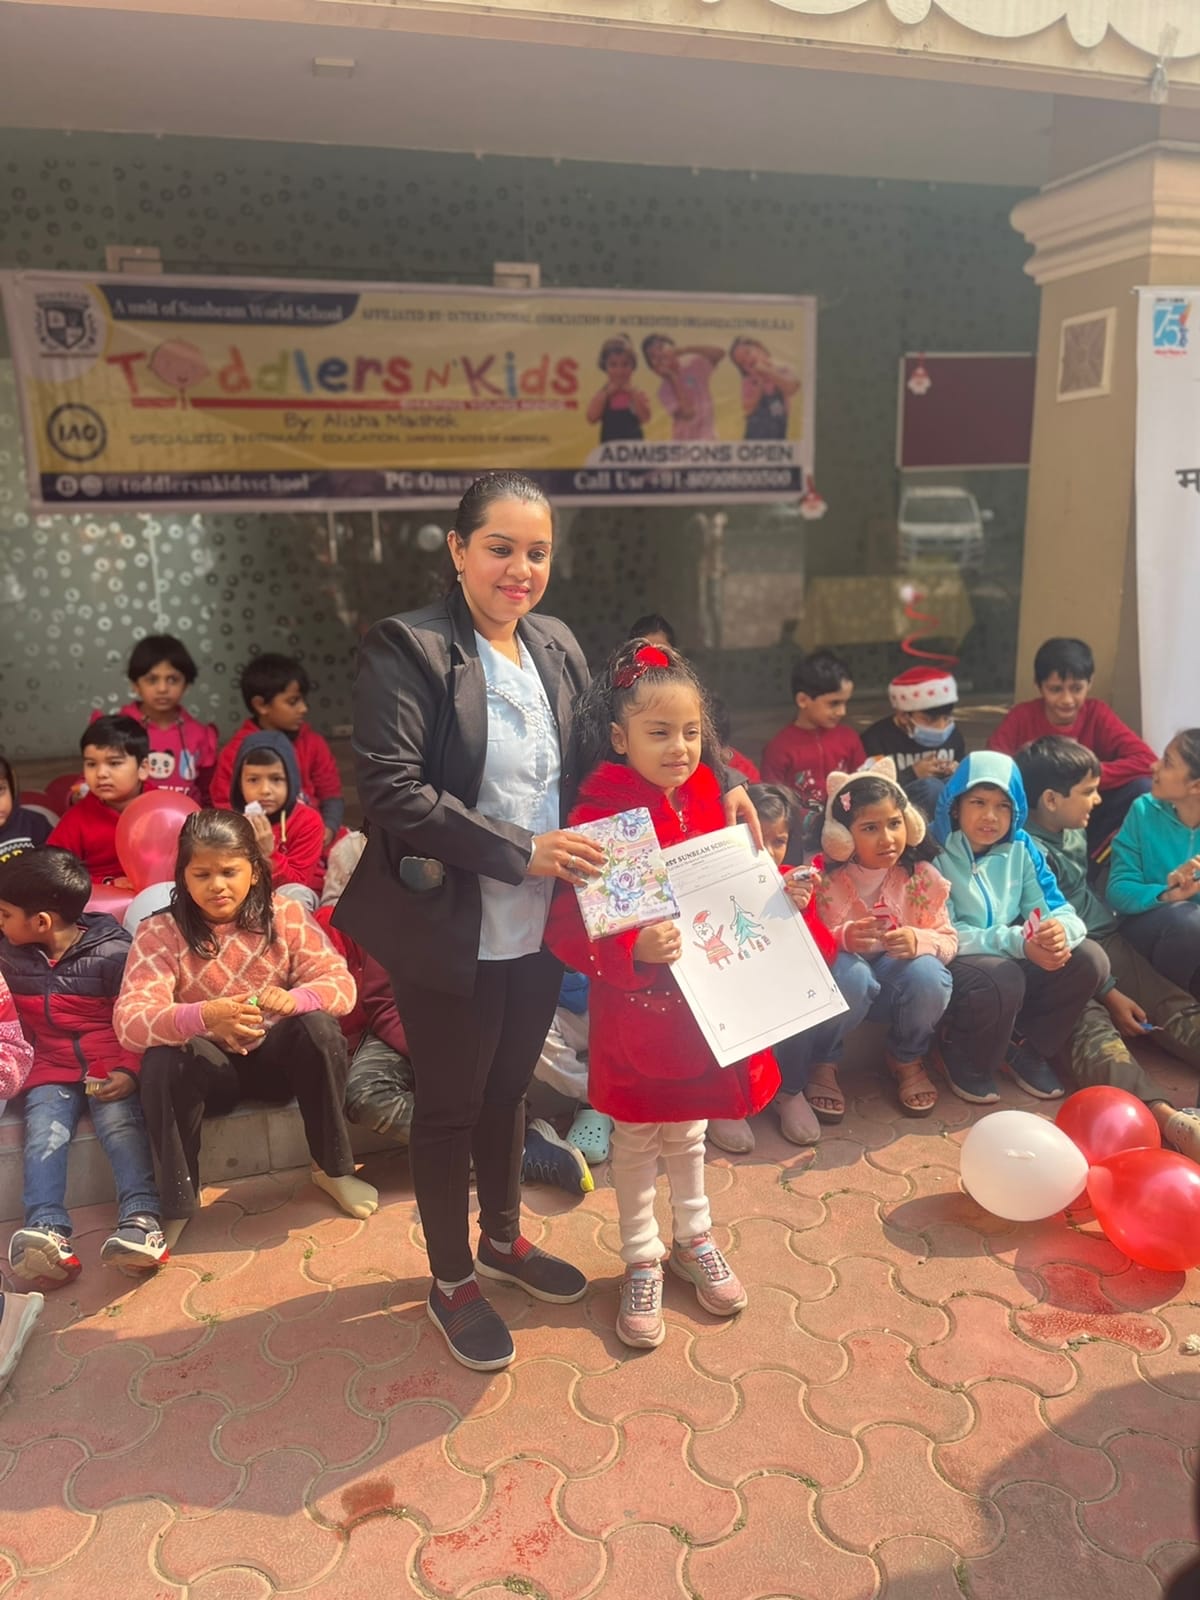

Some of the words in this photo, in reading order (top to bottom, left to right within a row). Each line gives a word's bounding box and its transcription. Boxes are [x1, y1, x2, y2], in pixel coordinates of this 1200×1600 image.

[113, 299, 126, 314] A
[128, 300, 158, 315] unit
[160, 300, 178, 315] of
[179, 301, 247, 318] Sunbeam
[248, 303, 294, 319] World
[295, 304, 343, 321] School
[460, 351, 580, 398] Kids
[600, 444, 732, 464] ADMISSIONS
[737, 444, 793, 462] OPEN
[384, 471, 412, 491] PG
[574, 470, 610, 490] Call
